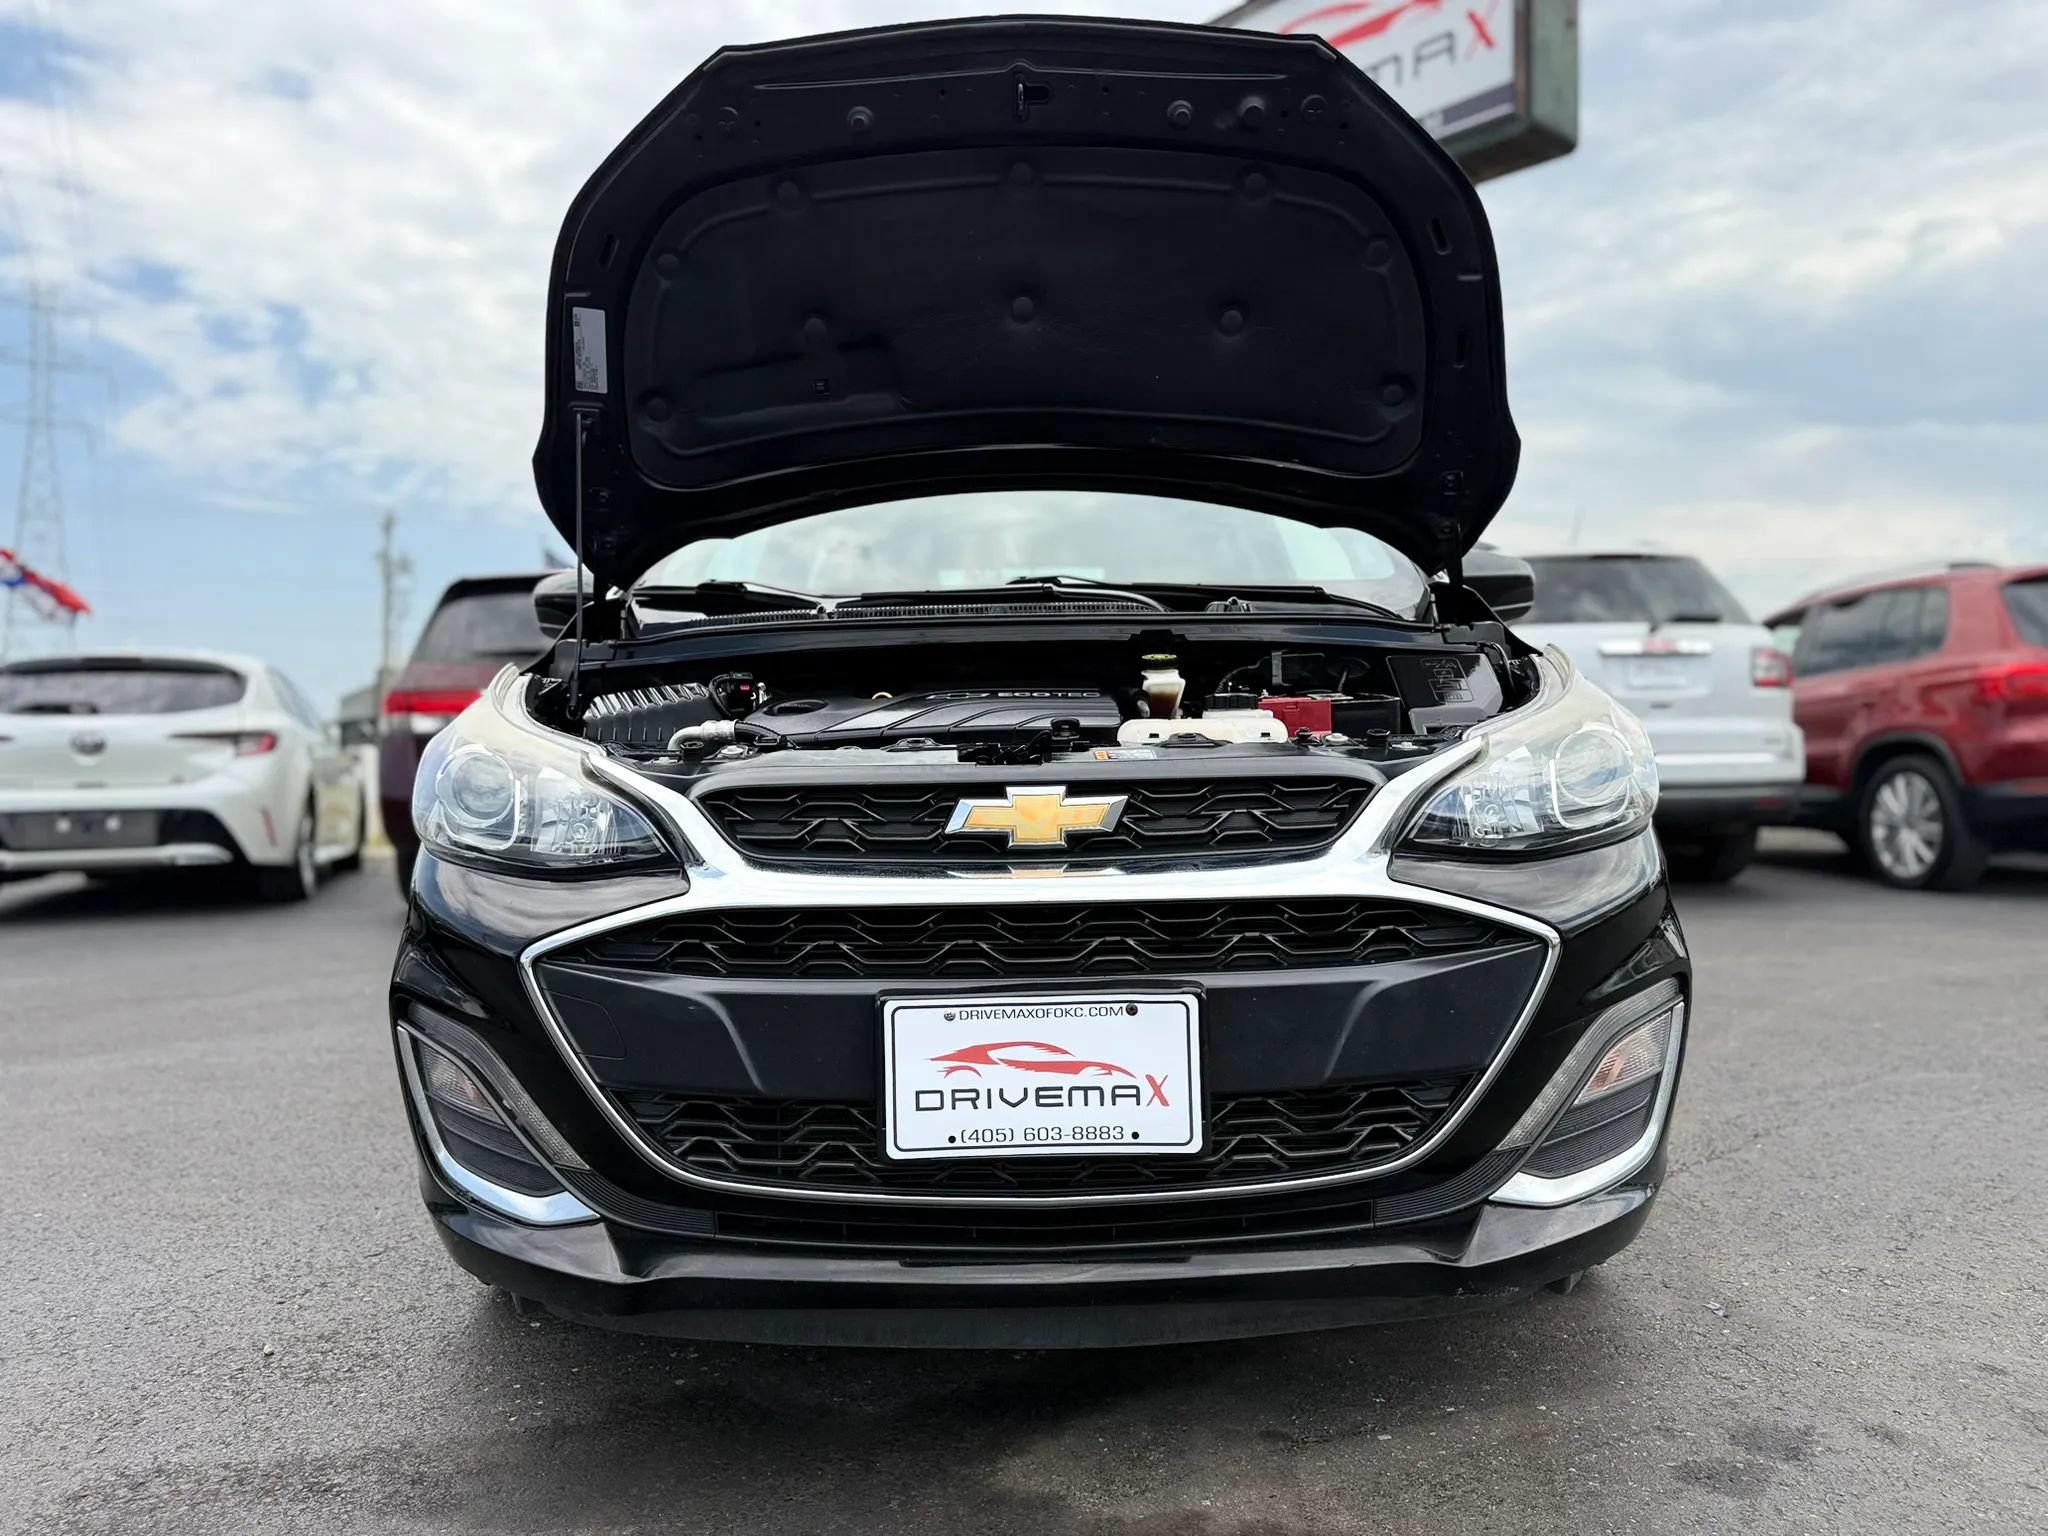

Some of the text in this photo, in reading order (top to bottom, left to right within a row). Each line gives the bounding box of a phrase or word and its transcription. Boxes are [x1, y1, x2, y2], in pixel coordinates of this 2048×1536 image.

[959, 1006, 1124, 1021] DRIVEMAXOFOKC.COM
[915, 1074, 1170, 1112] DRIVEMAX
[960, 1126, 1125, 1144] (405) 603-8883
